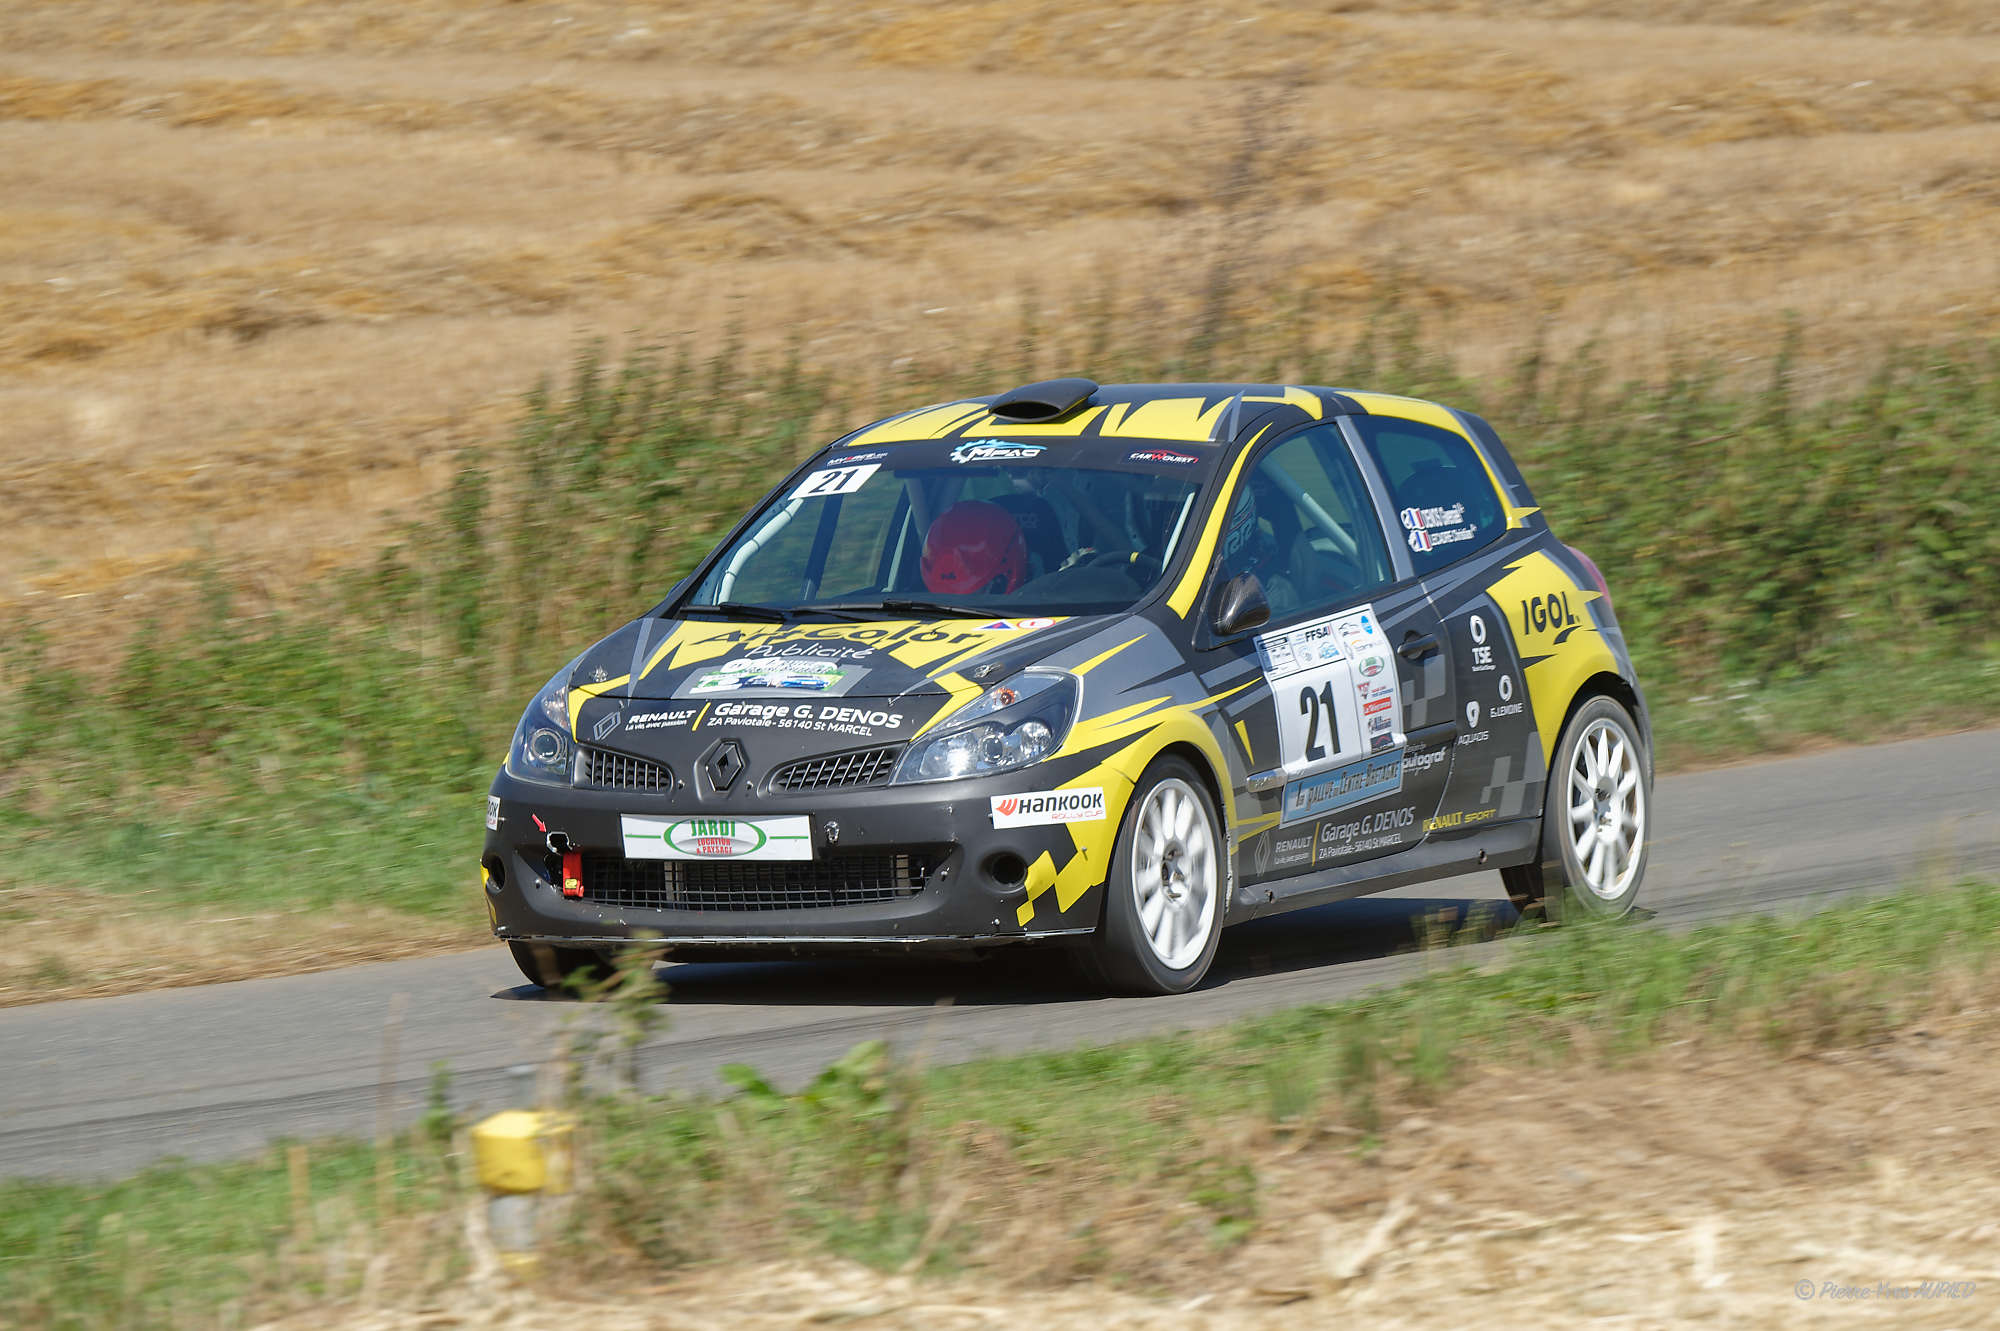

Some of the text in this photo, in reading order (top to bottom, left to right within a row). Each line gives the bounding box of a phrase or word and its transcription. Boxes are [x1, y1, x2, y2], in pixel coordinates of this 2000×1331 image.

[808, 468, 859, 494] 21
[1520, 591, 1575, 635] IGOL
[1305, 626, 1329, 642] FFSA
[745, 642, 875, 659] Publicité
[1472, 646, 1492, 664] TSE
[629, 710, 696, 723] RENAULT
[714, 702, 903, 728] Garage G. DENOS
[1300, 681, 1341, 762] 21
[706, 717, 722, 726] ZA
[778, 719, 812, 729] 56140
[813, 721, 825, 731] St
[827, 723, 873, 736] MARCEL
[1321, 806, 1417, 843] Garage G. DENOS
[1464, 809, 1497, 823] SPORT
[690, 819, 735, 837] JARDI
[697, 837, 731, 846] LOCATION
[703, 846, 733, 855] PAYSAGE
[1275, 836, 1313, 853] RENAULT
